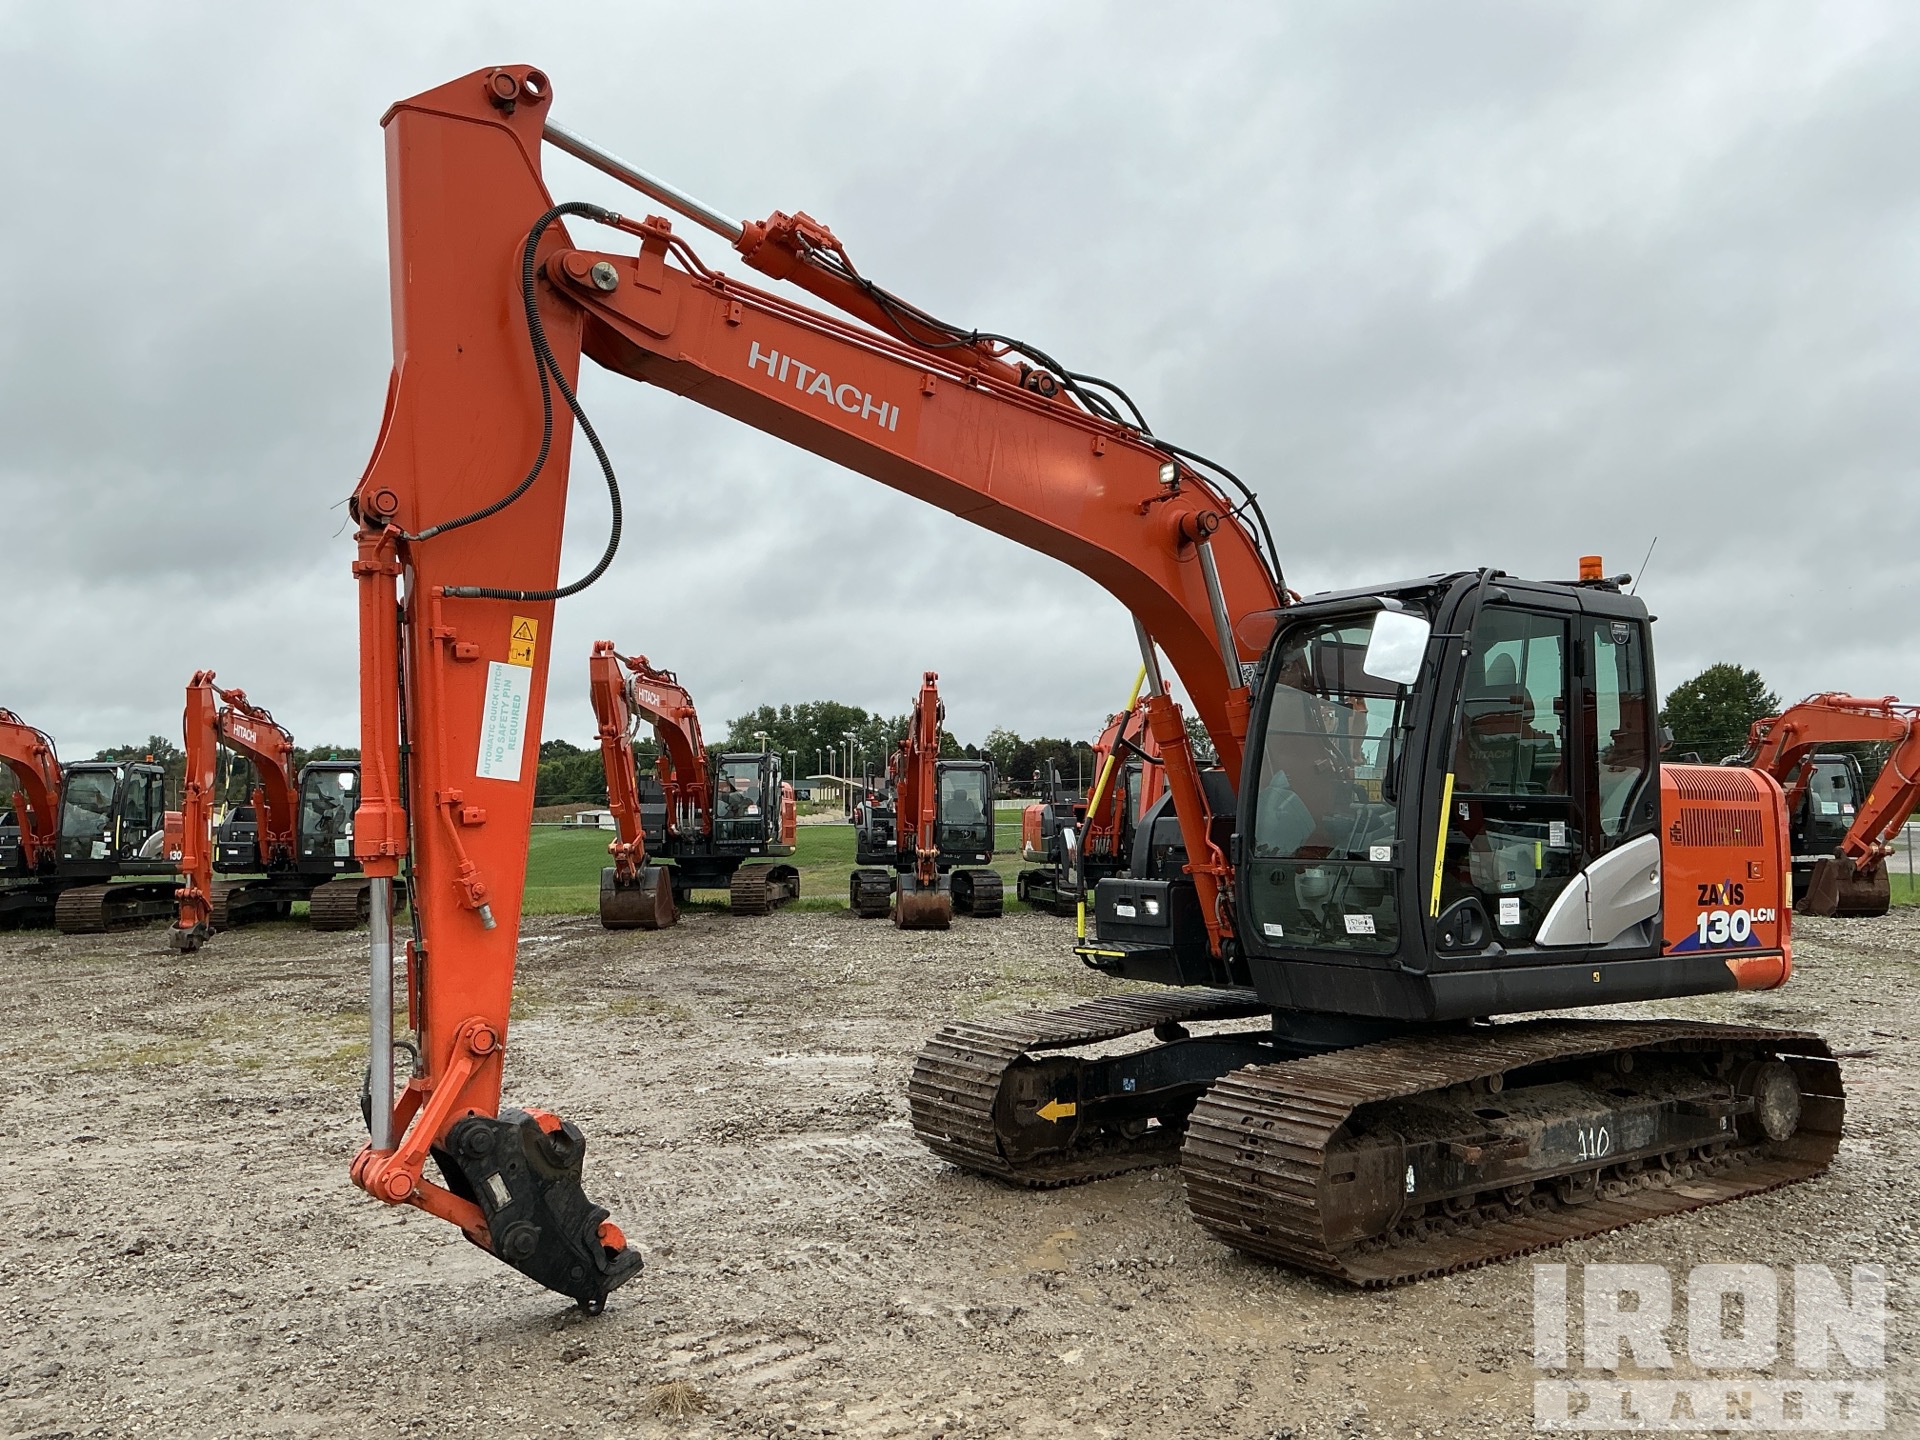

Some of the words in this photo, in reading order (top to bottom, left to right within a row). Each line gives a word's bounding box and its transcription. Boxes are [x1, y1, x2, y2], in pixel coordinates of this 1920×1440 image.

[748, 341, 899, 432] HITACHI
[494, 664, 503, 692] HITCH
[503, 679, 512, 698] PIN
[490, 693, 499, 723] QUICK
[638, 687, 660, 707] HITACHI
[233, 723, 257, 743] HITACHI
[498, 701, 510, 743] SAFETY
[508, 694, 521, 750] REQUIRED
[483, 723, 496, 775] AUTOMATIC
[495, 747, 504, 763] NO
[169, 850, 183, 860] 130
[1697, 879, 1744, 906] ZAXIS
[1578, 1126, 1610, 1160] 110
